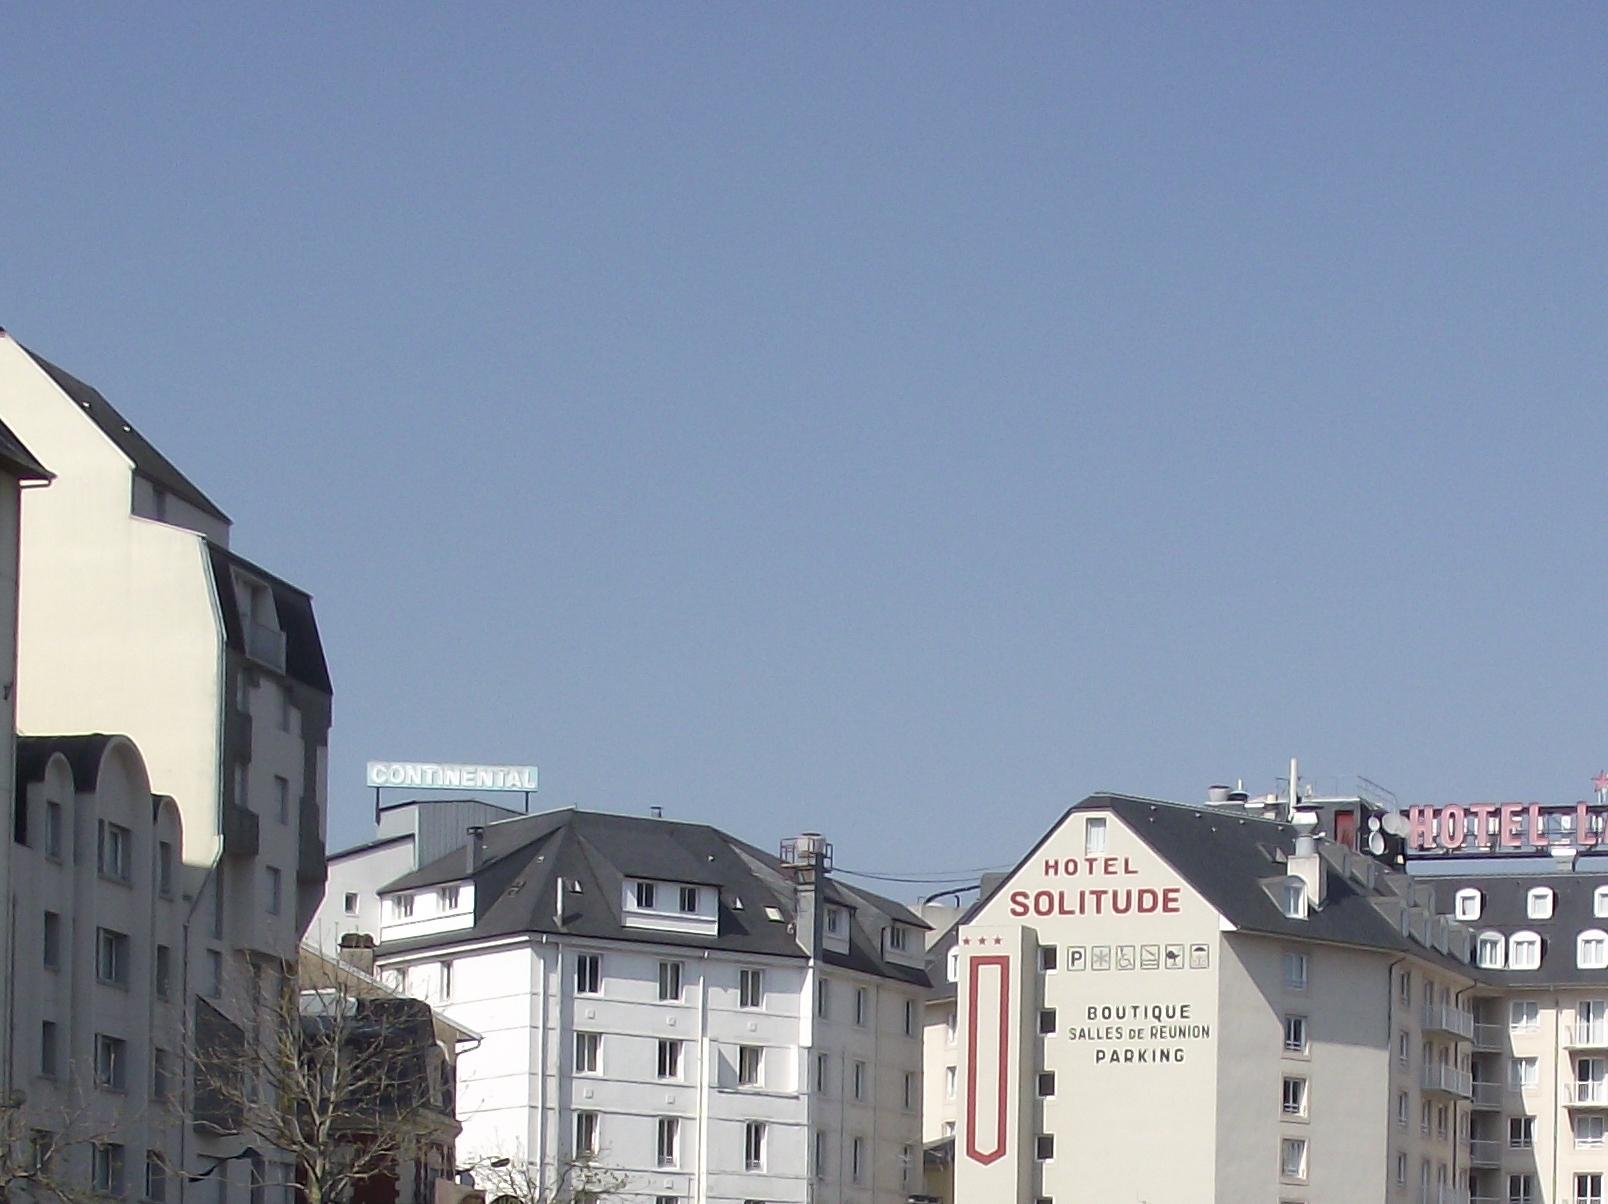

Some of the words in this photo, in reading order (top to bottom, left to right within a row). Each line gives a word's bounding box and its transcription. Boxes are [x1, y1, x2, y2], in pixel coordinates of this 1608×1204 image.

[371, 765, 536, 789] CONTINENTAL
[1409, 802, 1549, 849] HOTEL
[1044, 857, 1139, 877] HOTEL
[1010, 888, 1180, 916] SOLITUDE
[1070, 951, 1083, 967] P
[1087, 1004, 1191, 1022] BOUTIQUE
[1068, 1026, 1124, 1041] SALLES
[1128, 1028, 1145, 1040] DE
[1150, 1025, 1210, 1040] REUNION
[1095, 1048, 1185, 1064] PARKING
